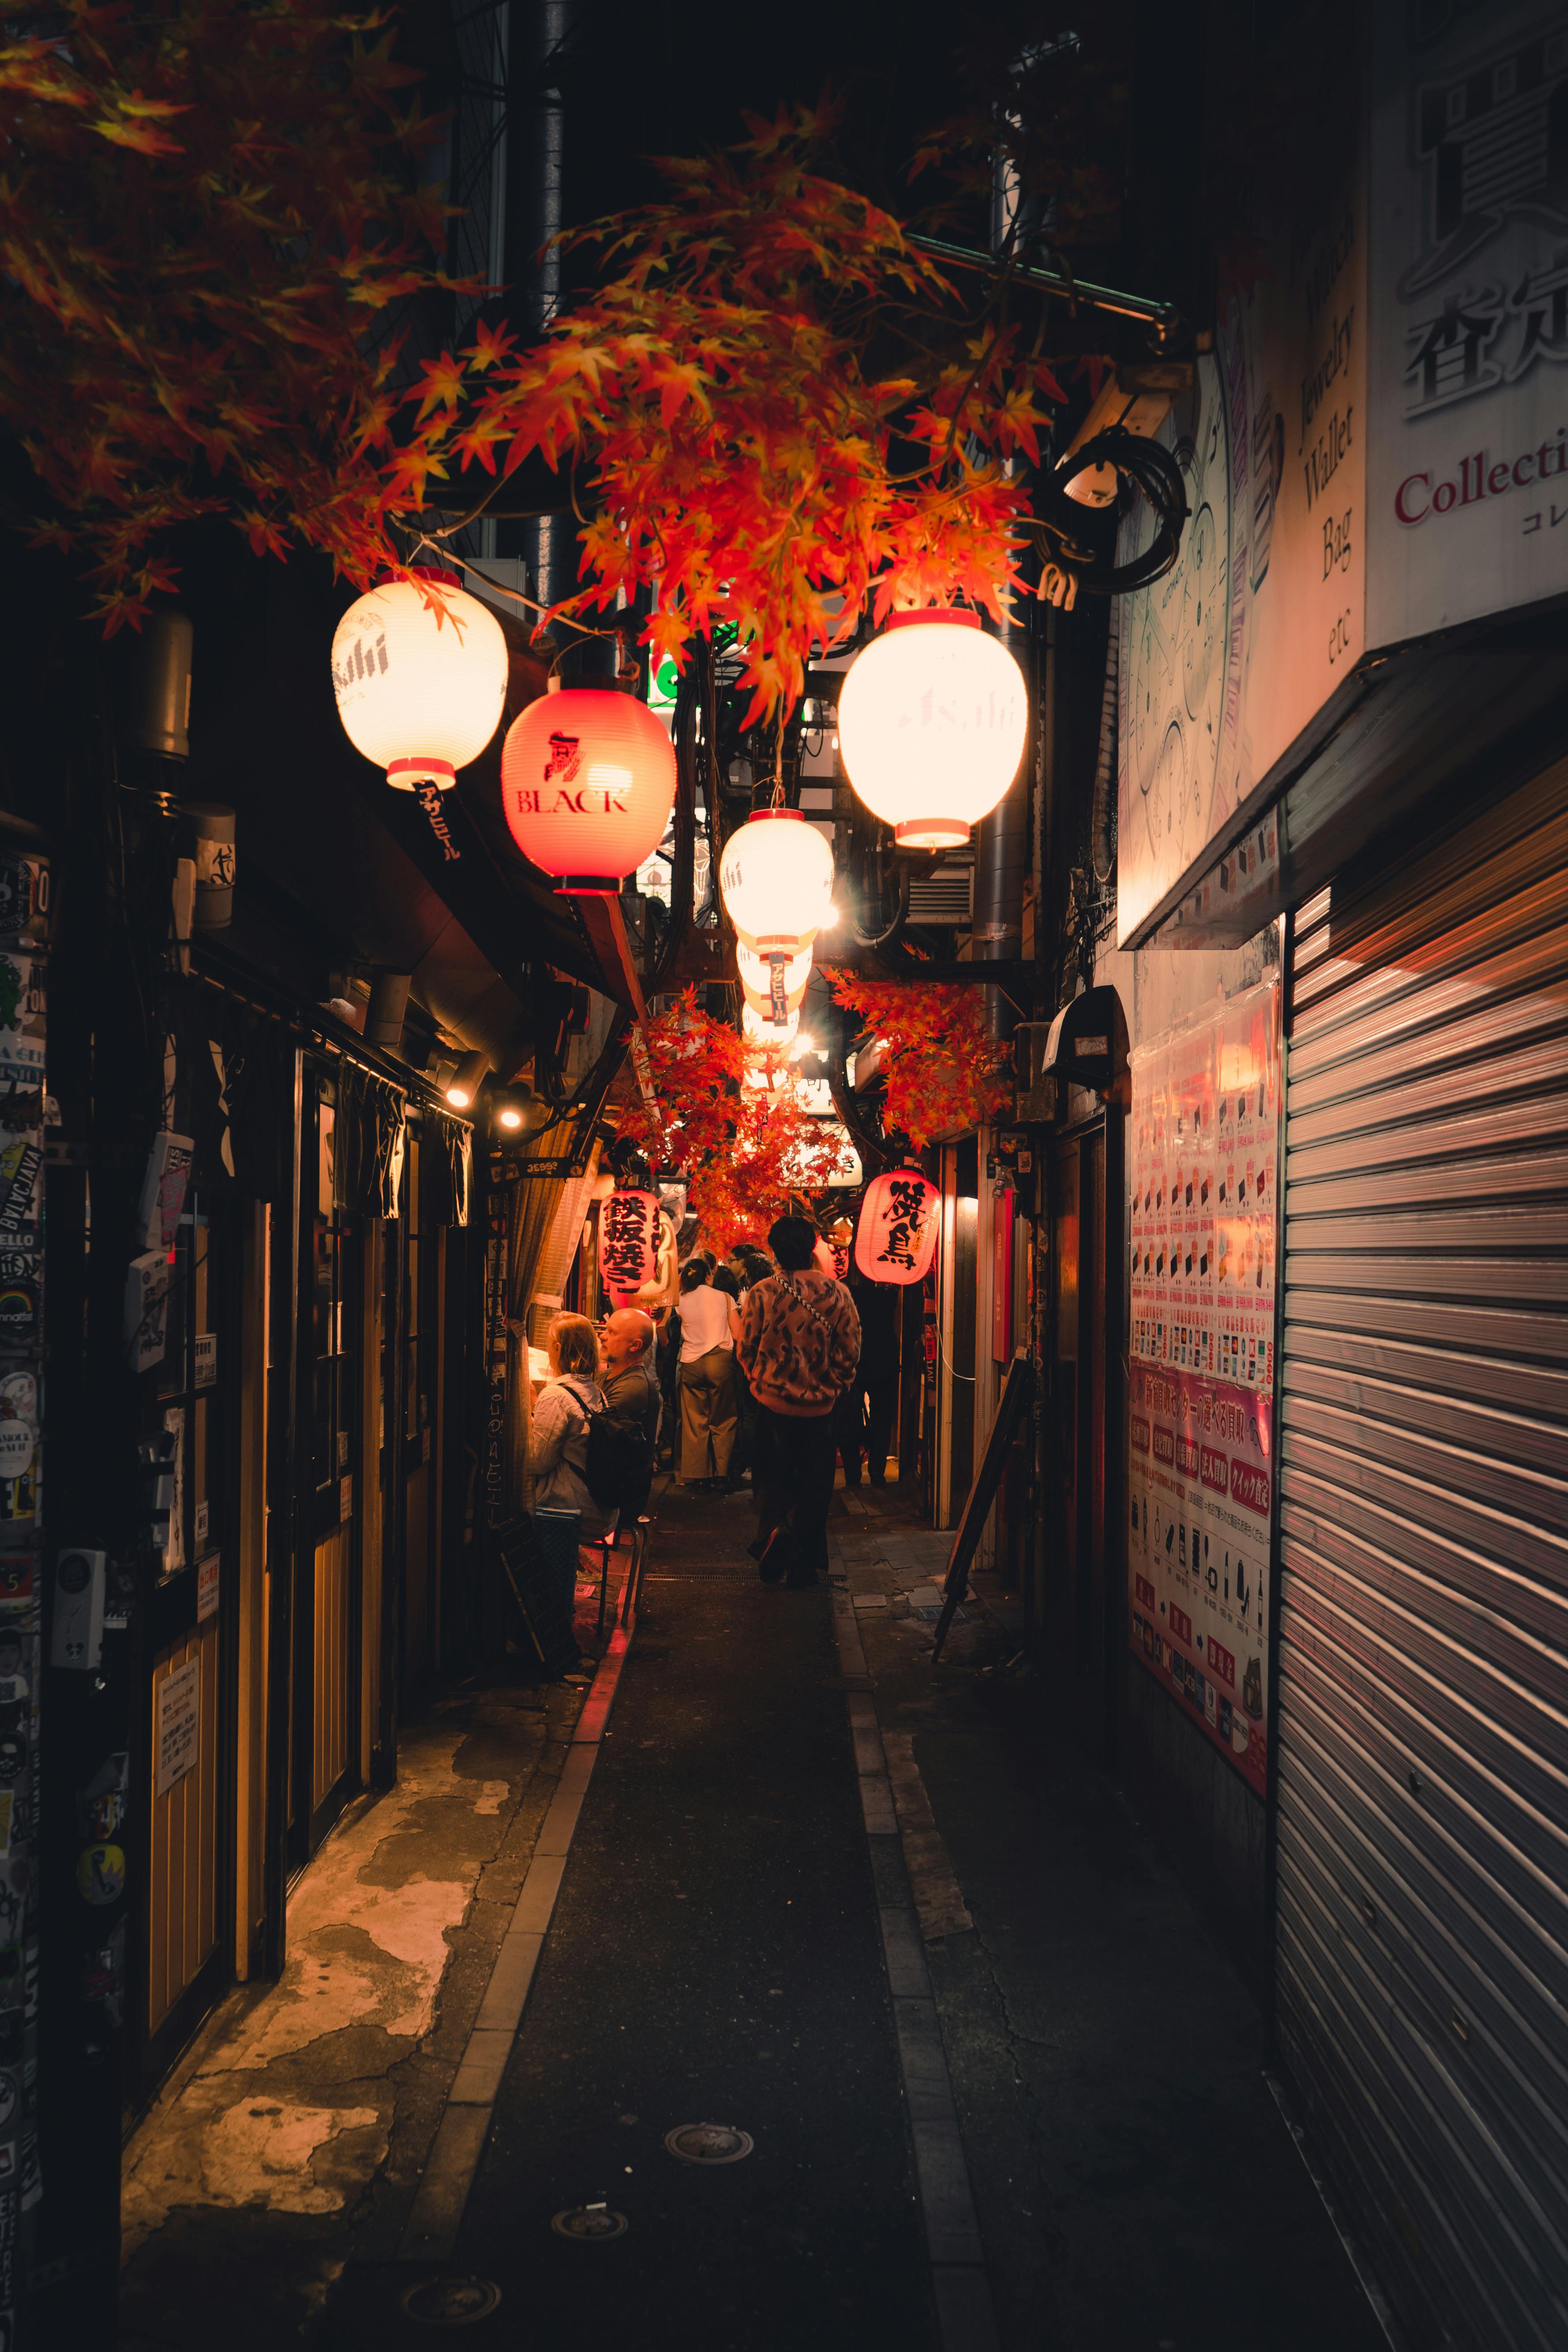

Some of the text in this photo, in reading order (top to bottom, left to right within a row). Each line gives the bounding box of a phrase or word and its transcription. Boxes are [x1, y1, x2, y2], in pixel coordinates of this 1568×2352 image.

[1299, 305, 1354, 456] Jewelry
[1304, 405, 1353, 513] Wallet
[1322, 508, 1352, 583] Bag
[1162, 560, 1184, 613] AUTOMATIC
[1329, 608, 1350, 664] etc
[419, 787, 461, 861] アサヒビール
[517, 790, 628, 813] BLACK
[772, 963, 786, 1020] アサヒビール
[603, 1197, 647, 1283] 鉄板焼き
[877, 1181, 927, 1271] 焼鳥
[1201, 1452, 1227, 1486] 法人買取
[1232, 1466, 1268, 1509] クイック査定
[1184, 1673, 1195, 1692] JCB
